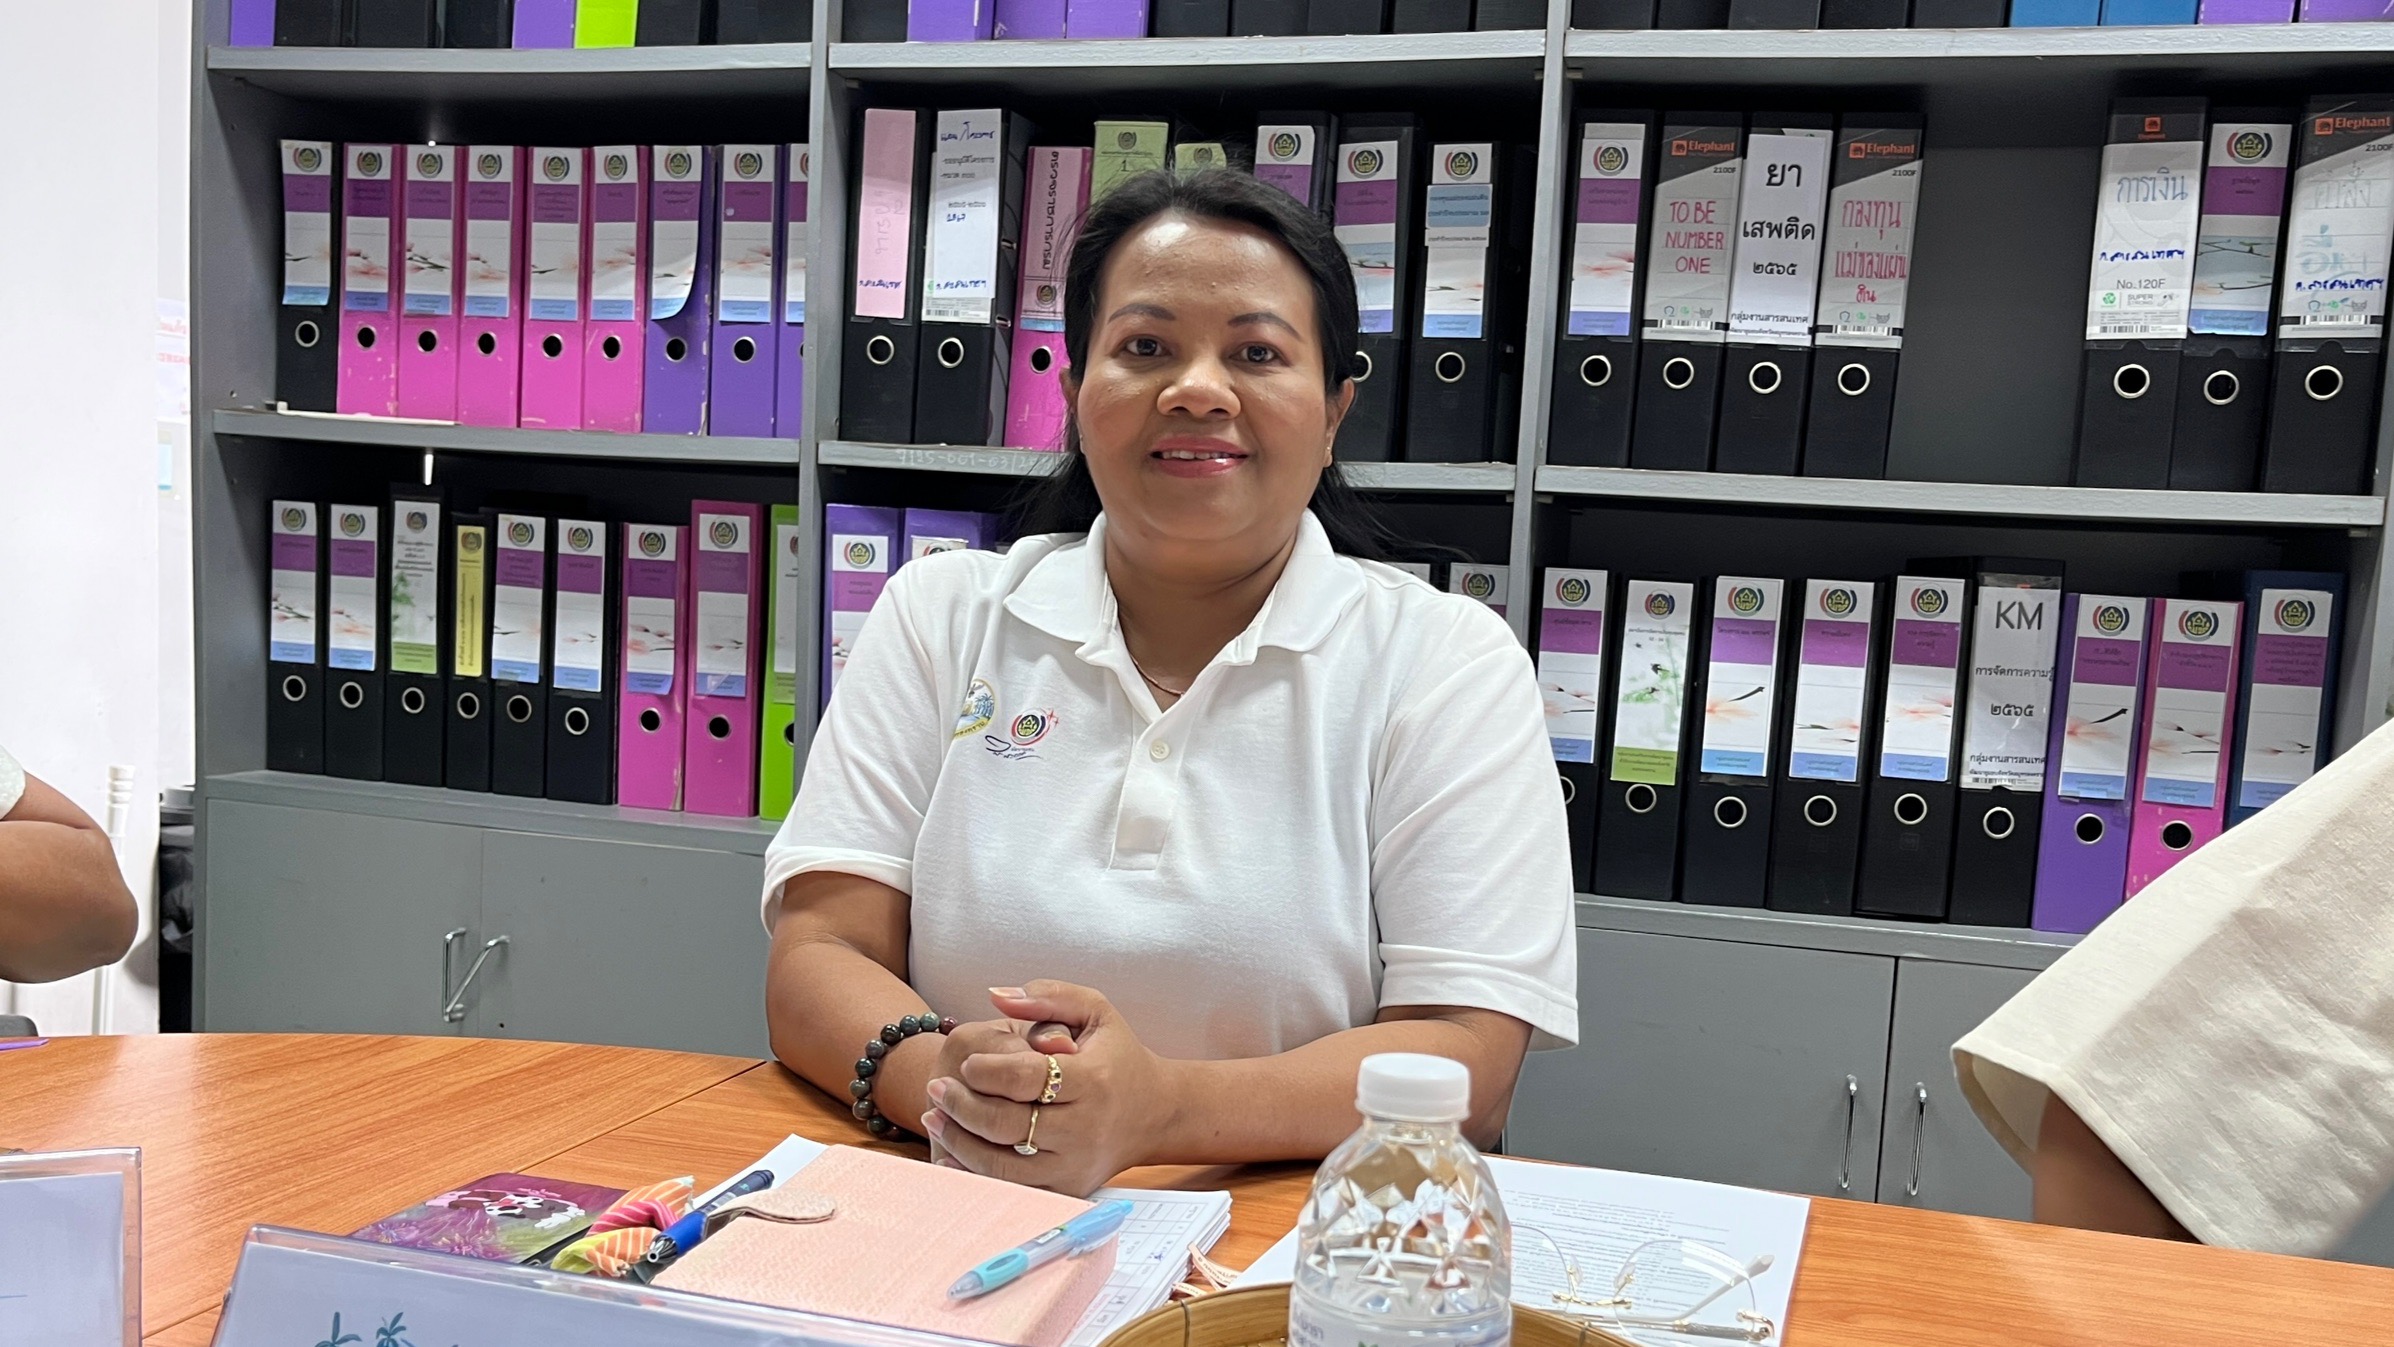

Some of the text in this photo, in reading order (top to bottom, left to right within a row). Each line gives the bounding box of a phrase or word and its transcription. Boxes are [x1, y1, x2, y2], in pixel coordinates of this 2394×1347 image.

[2335, 116, 2391, 129] Elephant
[1688, 140, 1735, 153] Elephant
[1866, 143, 1915, 155] Elephant
[1765, 163, 1802, 188] ยา
[2117, 166, 2188, 203] การเงิน
[1670, 200, 1716, 224] TO BE
[1841, 200, 1902, 240] กองทุน
[1742, 215, 1816, 241] เสพติด
[1665, 231, 1725, 250] NUMBER
[1675, 255, 1711, 274] ONE
[1752, 261, 1798, 276] ๒๕๖๕
[1731, 311, 1809, 324] กลุ่มงานสารสนเทศ
[1995, 600, 2044, 631] KM
[1990, 703, 2035, 717] ๒๕๖๕
